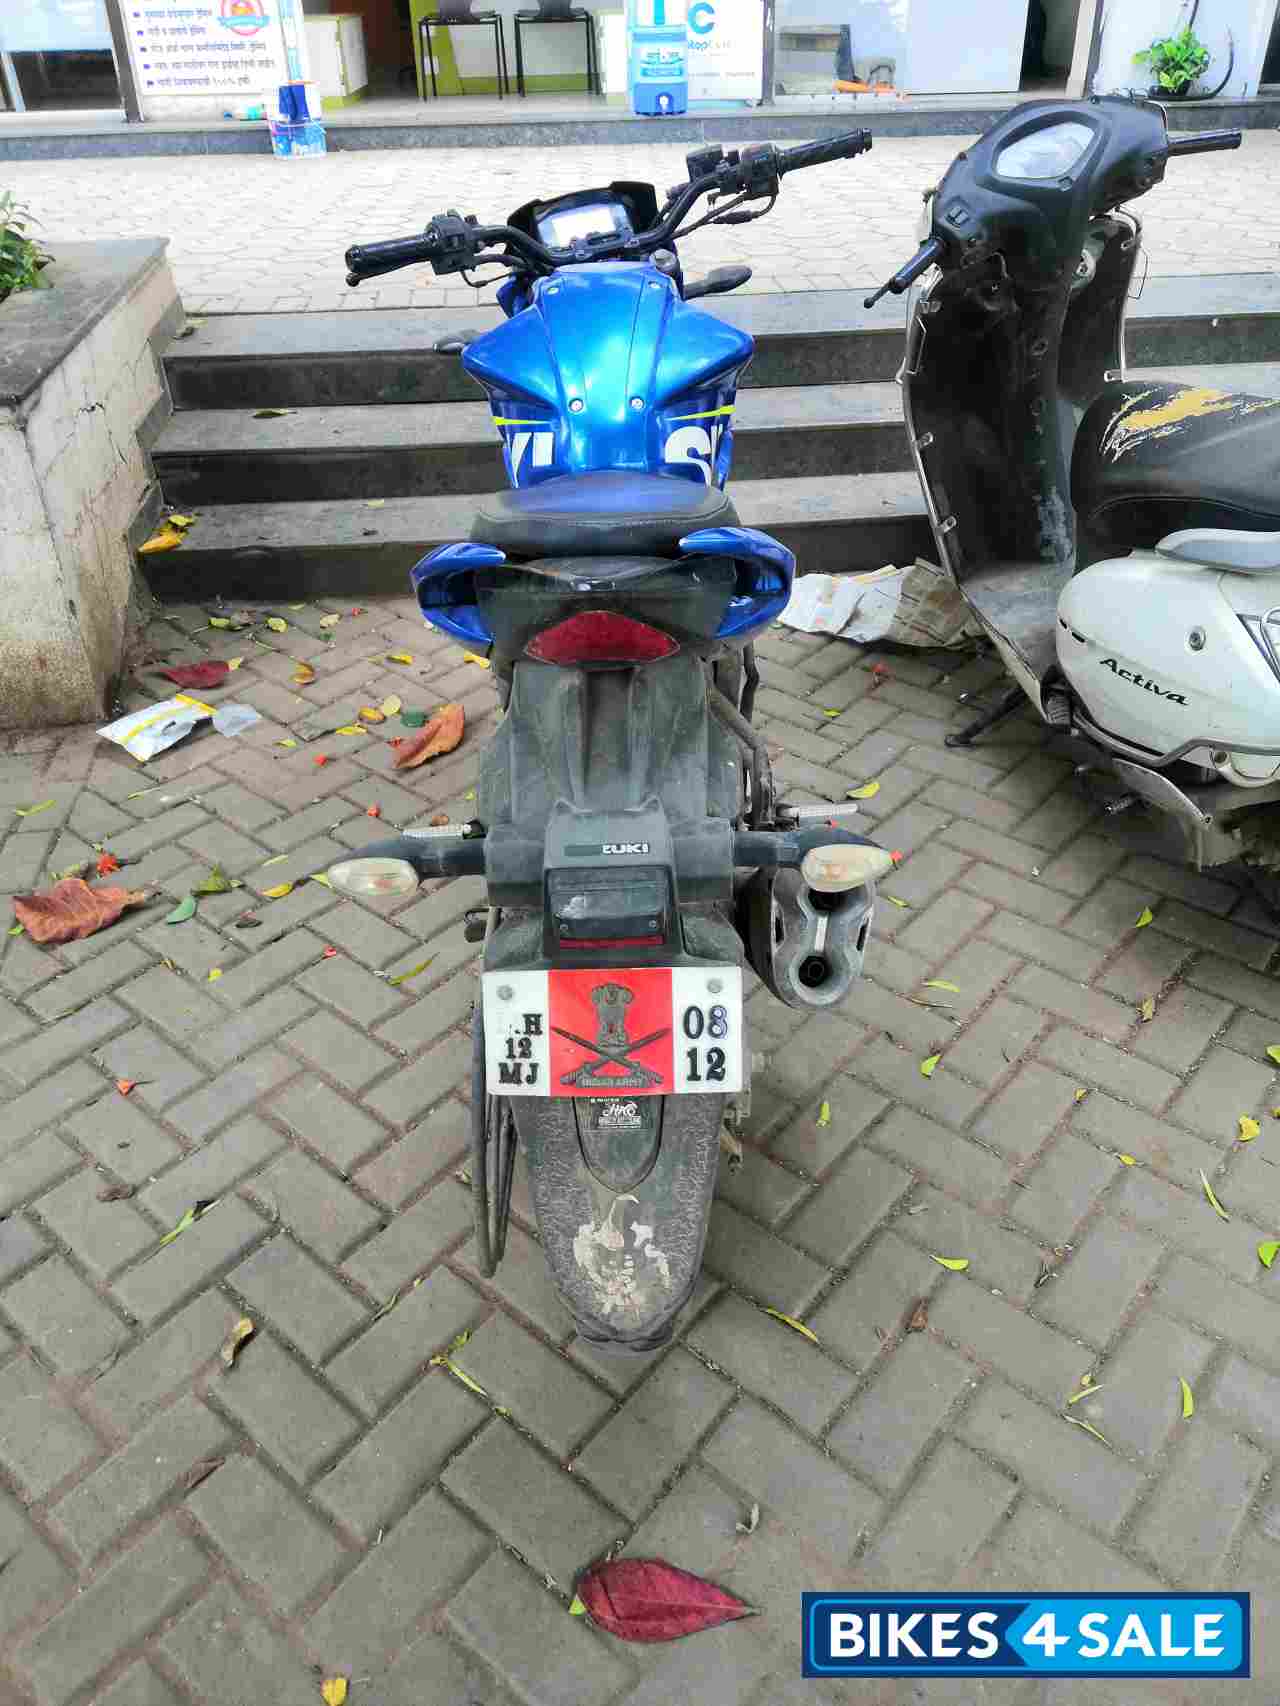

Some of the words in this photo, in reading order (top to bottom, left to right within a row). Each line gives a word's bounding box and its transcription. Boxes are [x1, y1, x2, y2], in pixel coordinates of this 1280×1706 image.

[1100, 657, 1190, 706] Activa
[683, 1005, 728, 1039] 08
[506, 1037, 532, 1059] 12
[686, 1046, 726, 1081] 12
[498, 1062, 539, 1085] MJ
